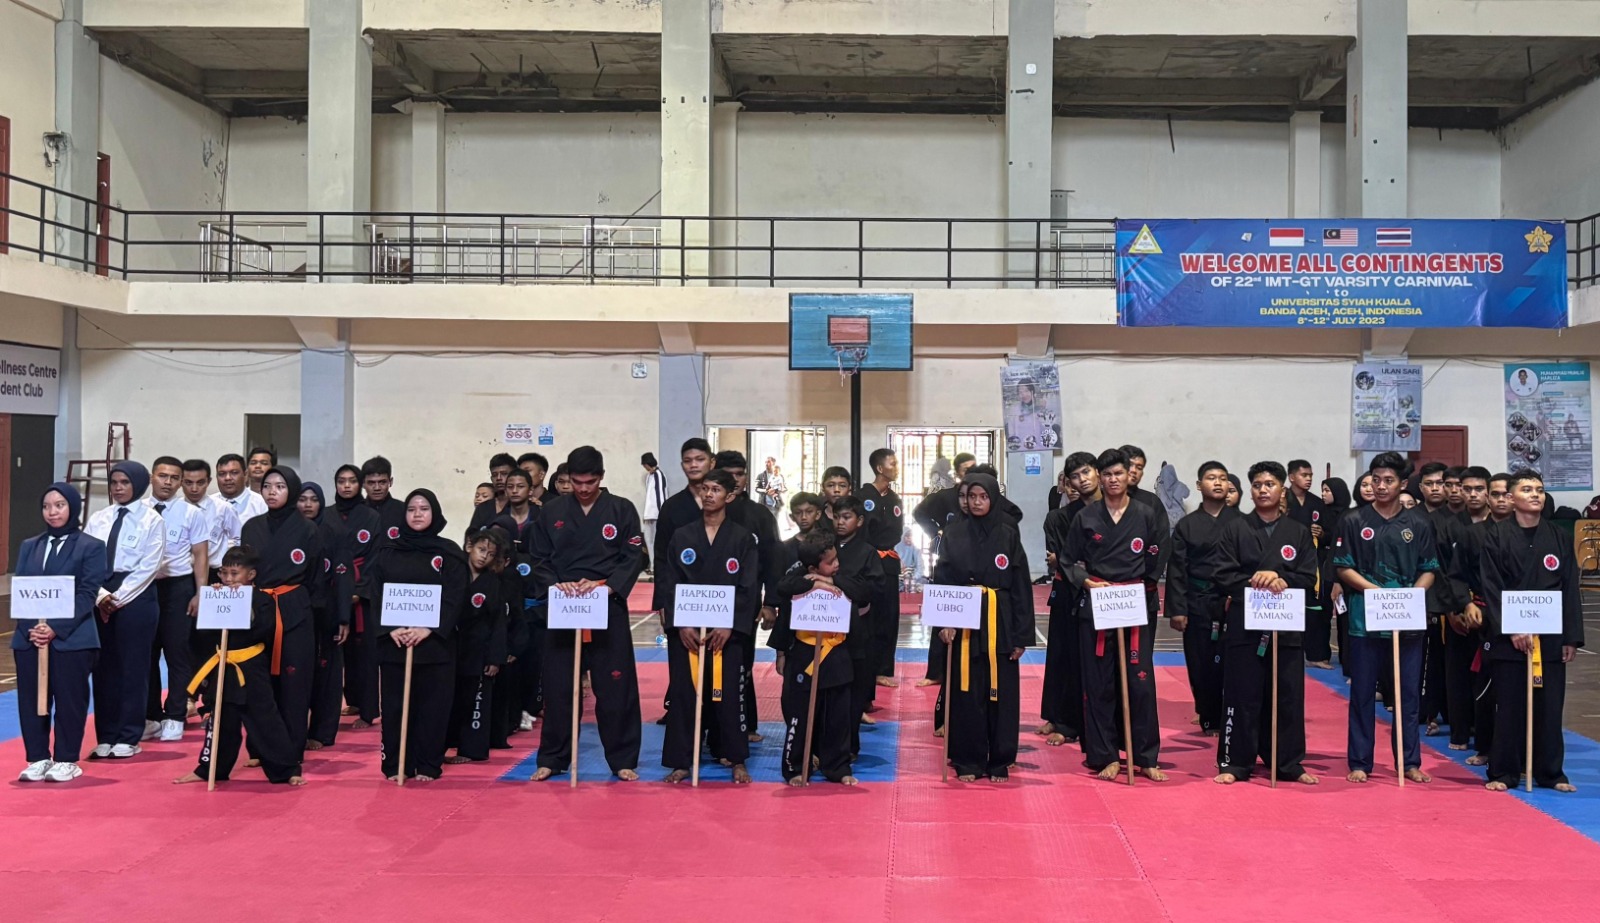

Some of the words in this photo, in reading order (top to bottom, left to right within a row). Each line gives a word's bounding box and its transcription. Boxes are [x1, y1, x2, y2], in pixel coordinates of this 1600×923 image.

[1180, 253, 1292, 273] WELCOME
[1295, 253, 1337, 273] ALL
[1341, 253, 1503, 273] CONTINGENTS
[1211, 276, 1232, 287] OF
[1265, 276, 1321, 287] IMT-GT
[1324, 276, 1391, 287] VARSITY
[1394, 276, 1473, 287] CARNIVAL
[1334, 288, 1349, 297] to
[1271, 298, 1340, 306] UNIVERSITAS
[1342, 298, 1374, 306] SYIAH
[1375, 298, 1412, 306] KUALA
[1299, 308, 1331, 317] ACEH,
[1333, 308, 1364, 317] ACEH,
[1332, 317, 1357, 325] JULY
[1358, 317, 1386, 325] 2023
[0, 360, 27, 376] llness
[28, 362, 57, 379] Centre
[23, 383, 43, 397] Club
[19, 589, 62, 599] WASIT
[205, 591, 245, 600] HAPKIDO
[389, 588, 433, 598] HAPKIDO
[681, 589, 726, 599] HAPKIDO
[929, 589, 973, 600] HAPKIDO
[1096, 588, 1137, 601] HAPKIDO
[1253, 592, 1293, 601] HAPKIDO
[1373, 592, 1413, 601] HAPKIDO
[1507, 595, 1553, 605] HAPKIDO
[216, 605, 231, 613] IOS
[385, 602, 434, 612] PLATINUM
[561, 605, 592, 614] AMIKI
[676, 603, 704, 612] ACEH
[705, 603, 729, 613] JAYA
[812, 603, 828, 611] UIN
[936, 603, 964, 613] UBBG
[1099, 600, 1136, 612] UNIMAL
[1260, 602, 1285, 610] ACEH
[1381, 602, 1406, 610] KOTA
[796, 614, 841, 623] AR-RANIRY
[1252, 611, 1294, 621] TAMIANG
[1376, 612, 1412, 621] LANGSA
[1520, 609, 1540, 619] USK
[785, 717, 799, 772] HAPKI
